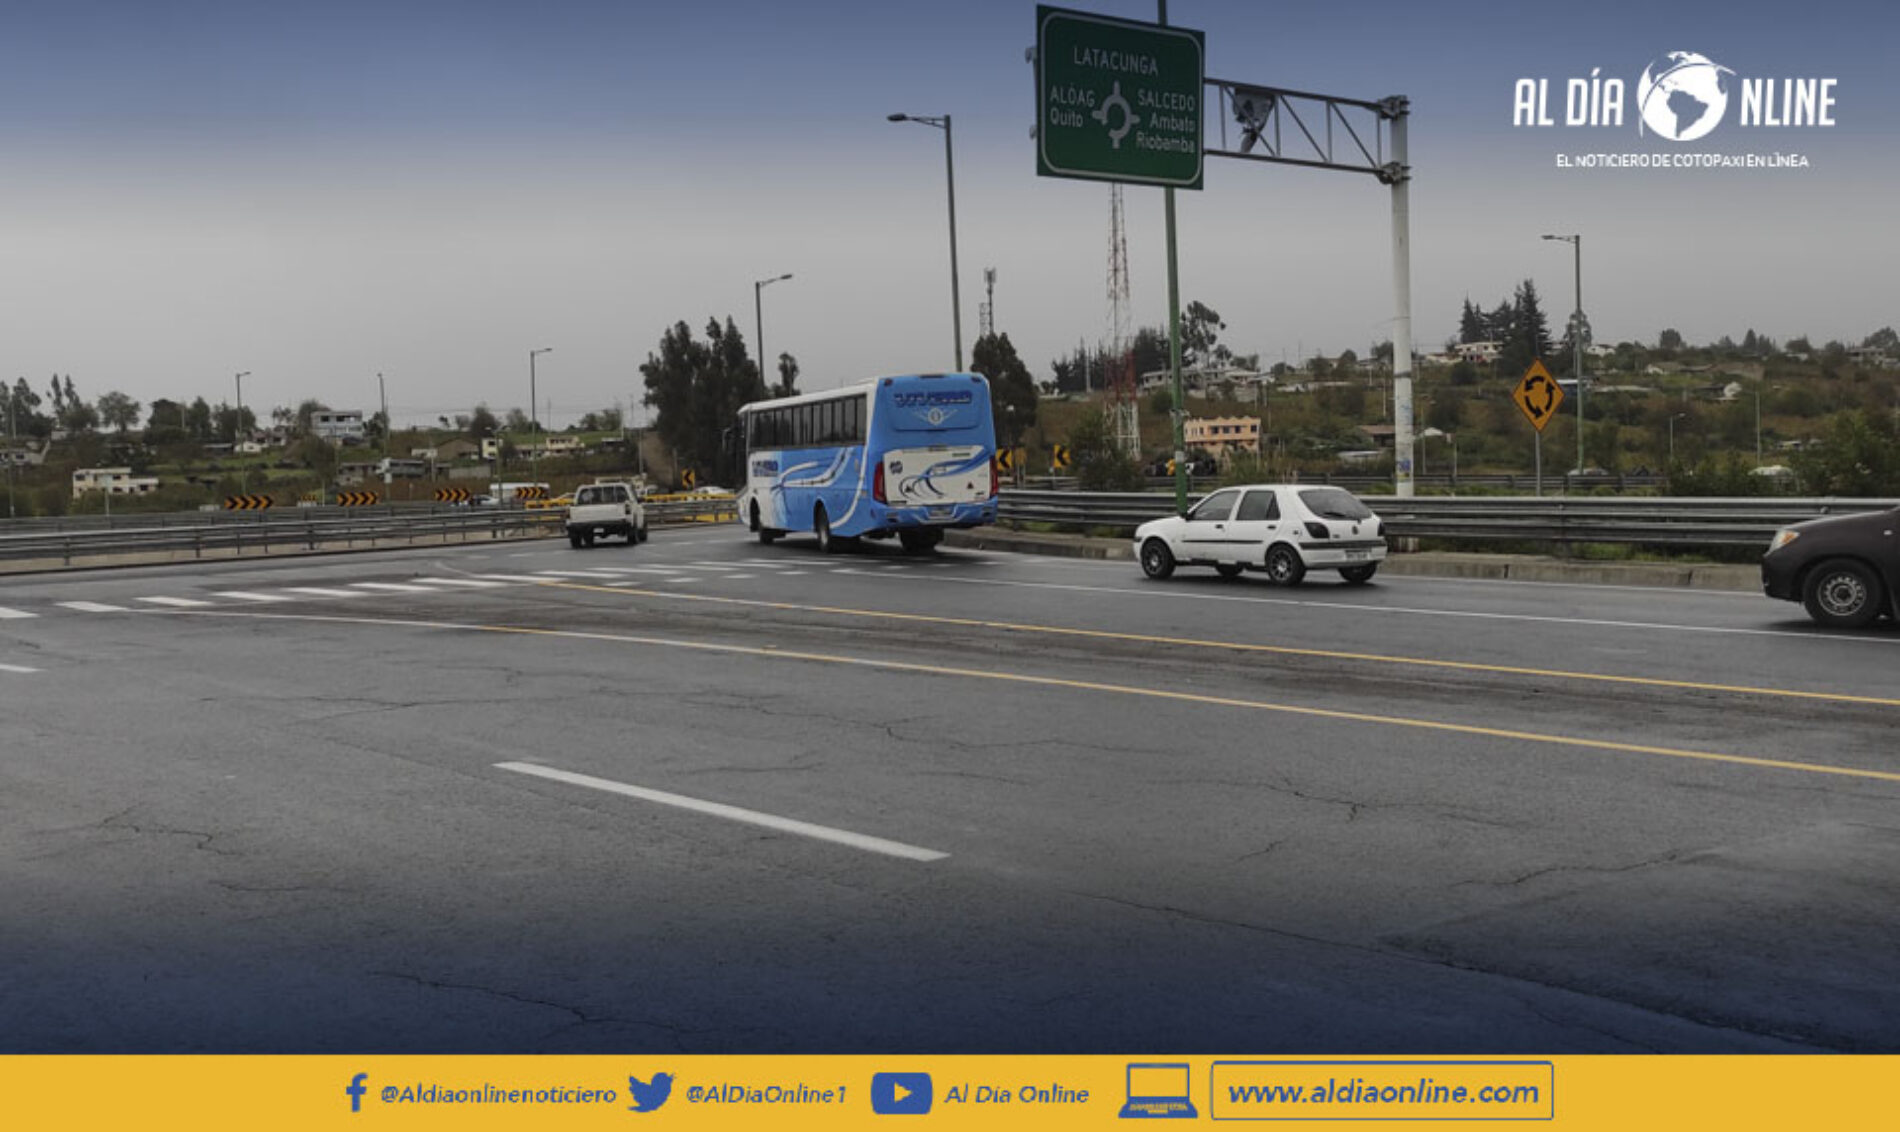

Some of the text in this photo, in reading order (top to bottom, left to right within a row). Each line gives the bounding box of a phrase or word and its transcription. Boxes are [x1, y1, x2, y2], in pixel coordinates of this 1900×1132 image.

[1074, 46, 1158, 75] LATACUNGA
[1050, 84, 1095, 107] ALÓAG
[1137, 88, 1195, 110] SALCEDO
[1050, 108, 1083, 127] Quito
[1150, 112, 1195, 131] Ambato
[1136, 131, 1195, 152] Riobamba
